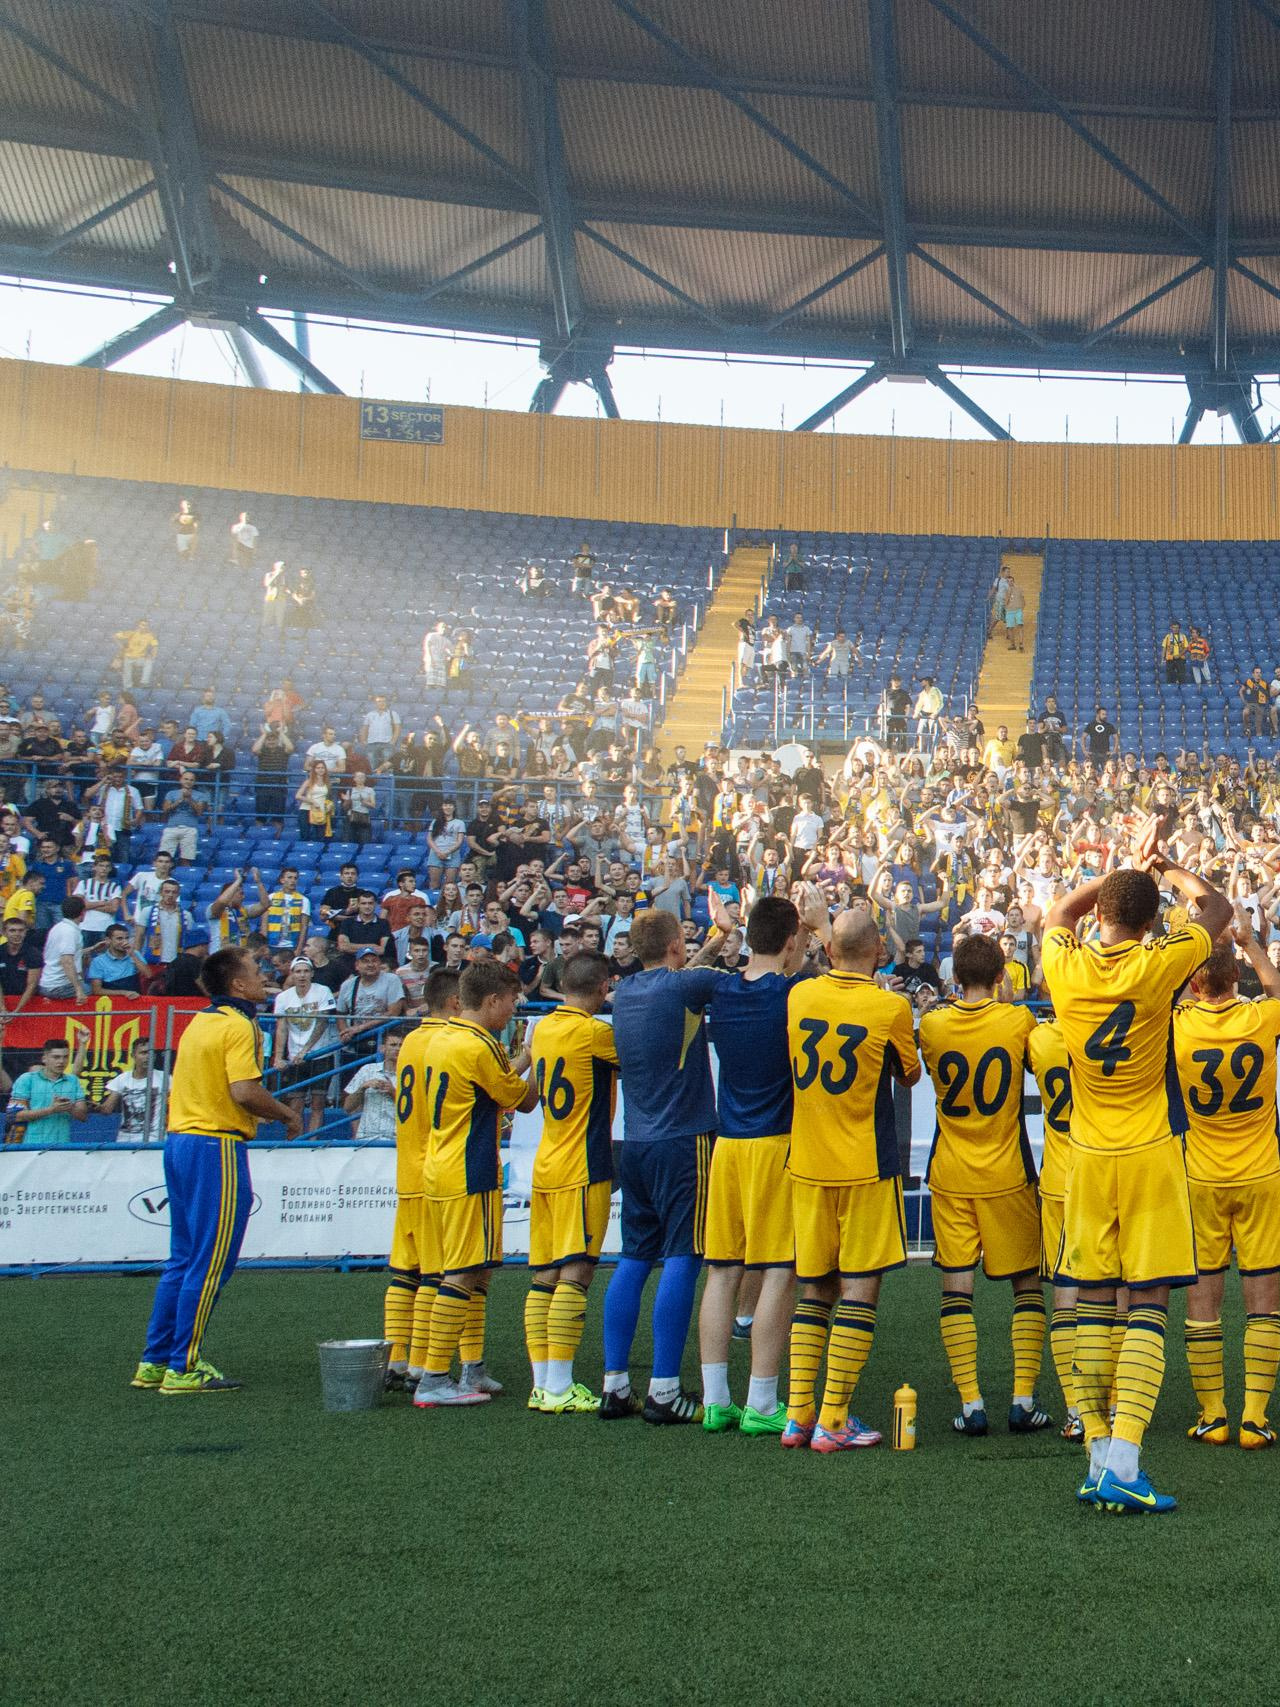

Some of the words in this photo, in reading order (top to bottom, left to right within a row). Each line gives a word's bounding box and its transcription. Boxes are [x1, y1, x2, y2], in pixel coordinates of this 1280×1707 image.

[364, 405, 390, 423] 13
[391, 411, 442, 423] SECTOR
[793, 1018, 868, 1095] 33
[1085, 1001, 1135, 1077] 4
[937, 1046, 1011, 1117] 20
[1189, 1042, 1264, 1117] 32
